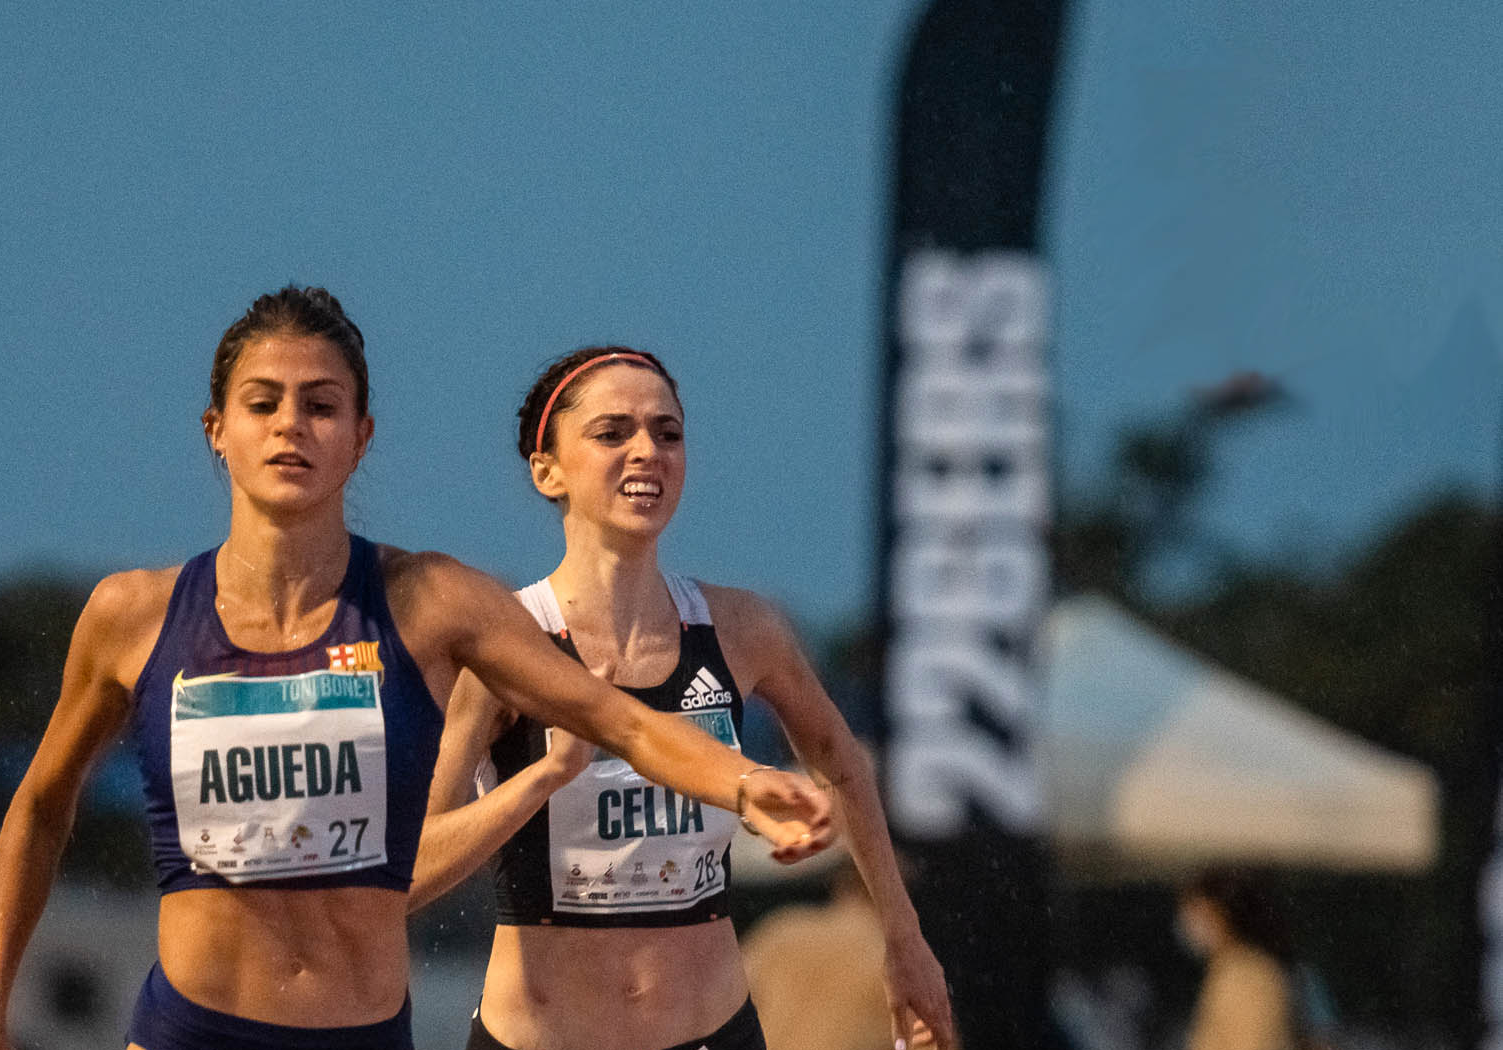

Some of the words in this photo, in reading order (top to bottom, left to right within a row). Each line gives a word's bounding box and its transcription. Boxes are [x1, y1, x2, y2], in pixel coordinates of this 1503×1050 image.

[280, 677, 316, 702] TONI
[319, 673, 373, 699] BONET
[680, 690, 733, 711] adidas
[199, 740, 362, 805] AGUEDA
[597, 785, 705, 841] CELIA
[328, 817, 370, 858] 27
